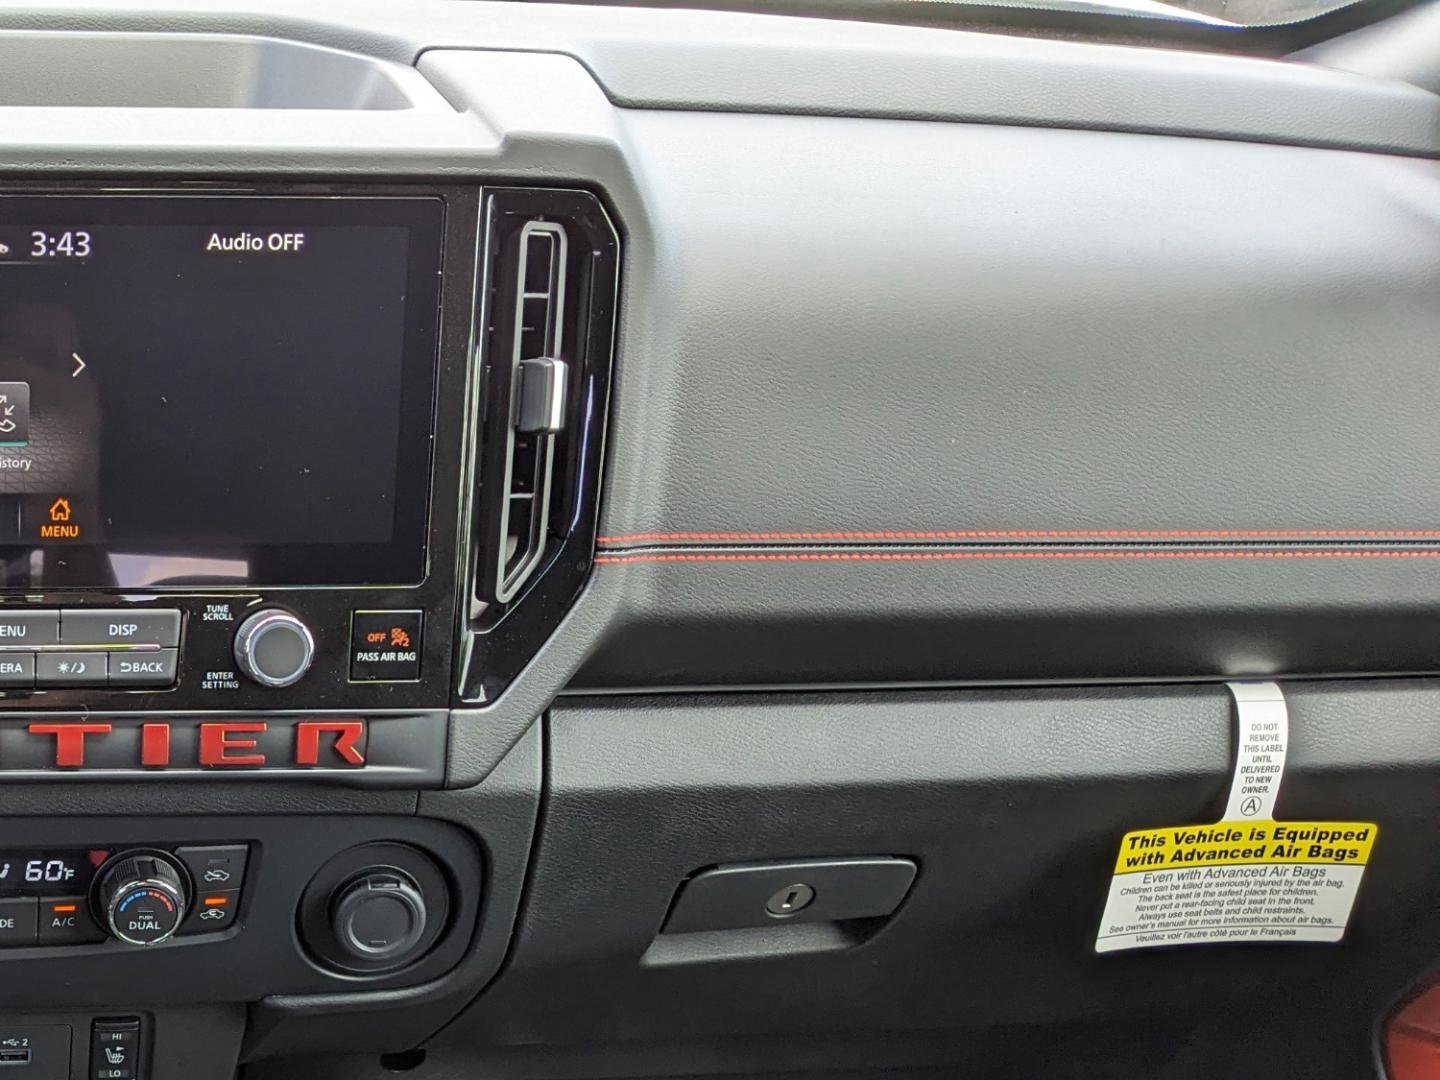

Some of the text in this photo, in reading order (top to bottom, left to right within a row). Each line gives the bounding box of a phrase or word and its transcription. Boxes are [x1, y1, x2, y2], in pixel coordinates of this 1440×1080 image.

[30, 231, 91, 257] 3:43
[207, 233, 305, 251] Audio OFF
[40, 525, 80, 538] MENU
[206, 606, 230, 614] TUNE
[202, 612, 234, 621] SCROLL
[108, 624, 138, 637] DISP
[368, 633, 387, 643] OFF
[356, 652, 417, 662] PASS AIR BAG
[132, 662, 164, 674] BACK
[206, 672, 234, 681] ENTER
[202, 680, 239, 690] SETTING
[1251, 723, 1278, 731] DO NOT
[1250, 734, 1280, 742] REMOVE
[1244, 744, 1284, 753] THIS LABEL
[1252, 755, 1273, 763] UNTIL
[1241, 766, 1280, 774] DELIVERED
[1245, 776, 1273, 784] TO NEW
[1242, 786, 1270, 794] OWNER.
[1128, 826, 1370, 850] This Vehicle is Equipped
[1126, 844, 1359, 868] with Advanced Air Bags
[1142, 866, 1327, 885] Even with Advanced Air Bags
[1120, 886, 1153, 897] Children
[1170, 884, 1181, 892] be
[1182, 882, 1204, 890] killed
[1215, 880, 1252, 889] seriously
[1254, 879, 1283, 888] injured
[1284, 879, 1295, 888] by
[1296, 879, 1308, 887] the
[1326, 879, 1345, 889] bag.
[52, 918, 75, 928] A/C
[128, 921, 161, 930] DUAL
[1135, 932, 1166, 943] Veuillez
[1167, 932, 1182, 940] voir
[1210, 928, 1228, 937] côté
[1229, 929, 1249, 938] pour
[1250, 928, 1259, 936] le
[1260, 928, 1297, 937] Français
[109, 1070, 121, 1078] LO
